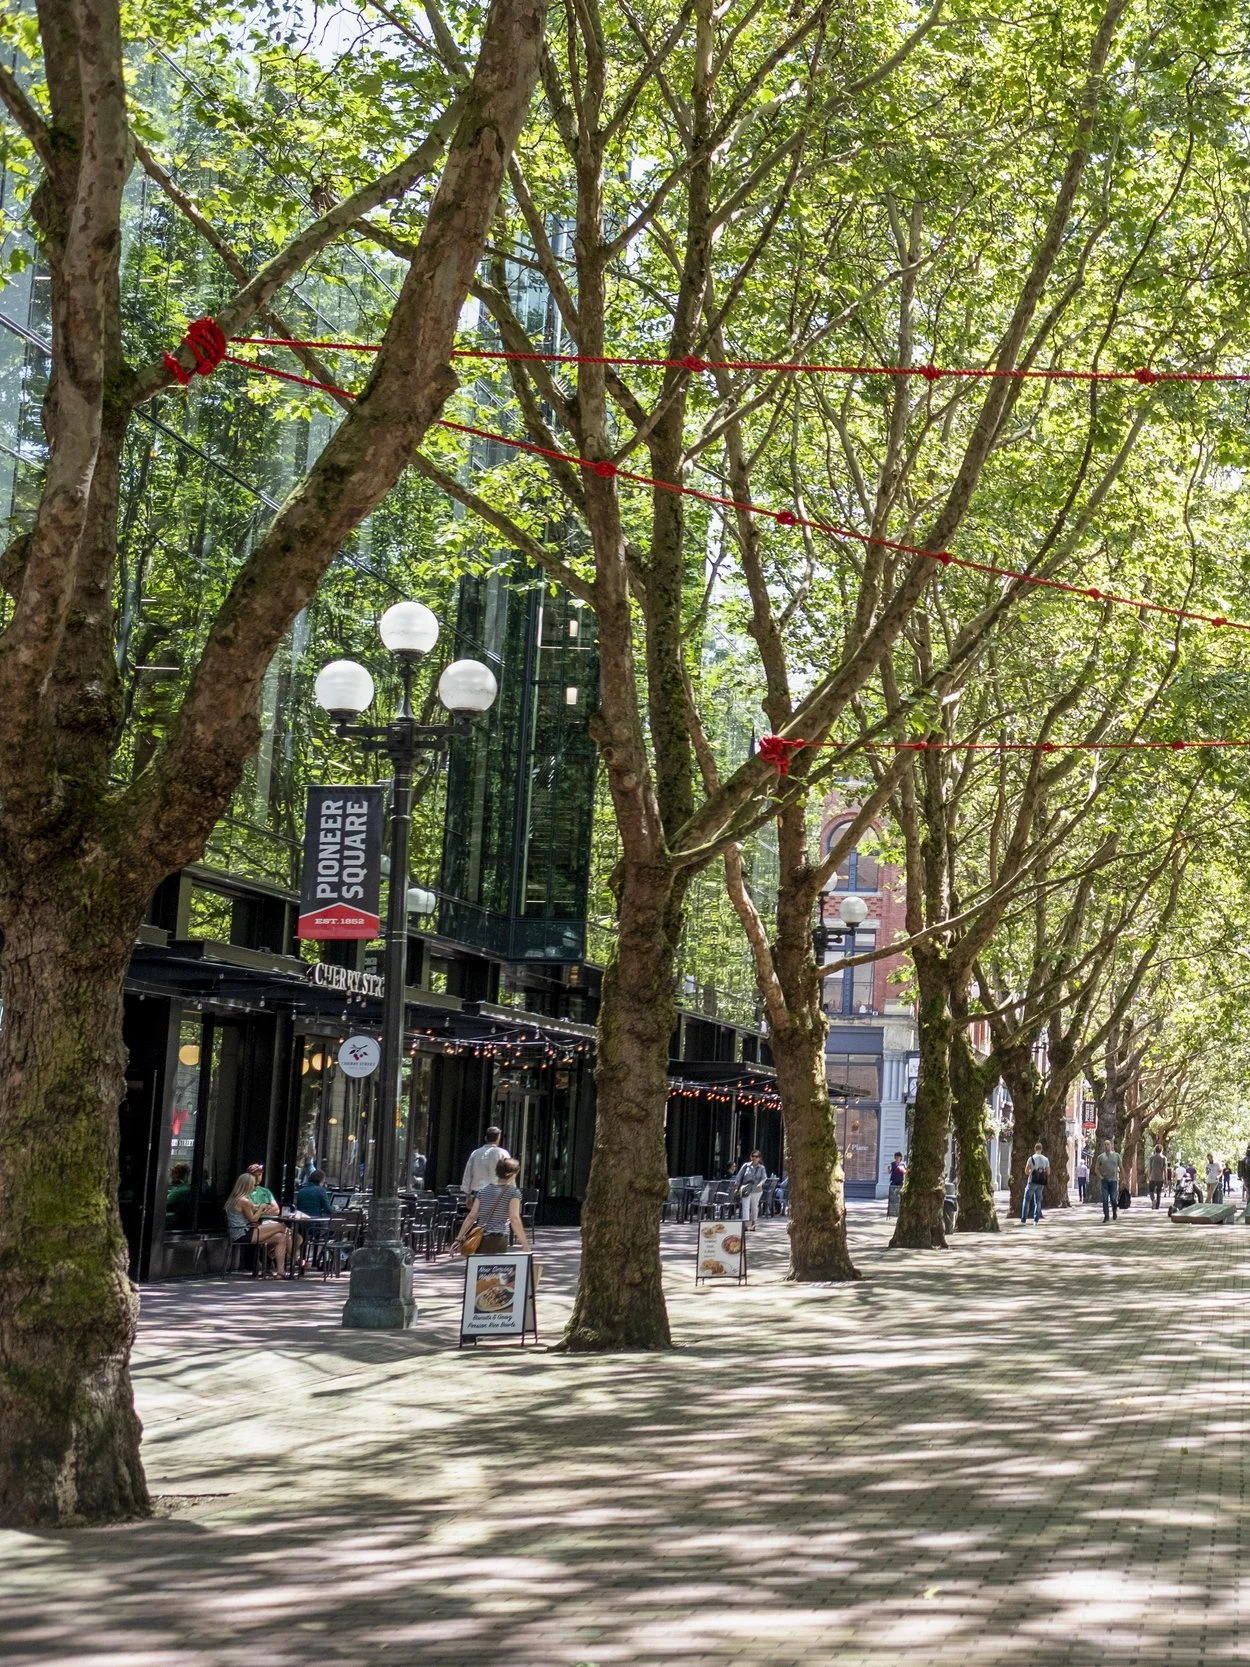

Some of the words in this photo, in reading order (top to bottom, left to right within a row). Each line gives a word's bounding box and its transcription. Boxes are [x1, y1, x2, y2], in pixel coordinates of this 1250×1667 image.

[316, 800, 343, 899] PIONEER
[342, 800, 368, 899] SQUARE
[315, 963, 361, 993] CHERRY
